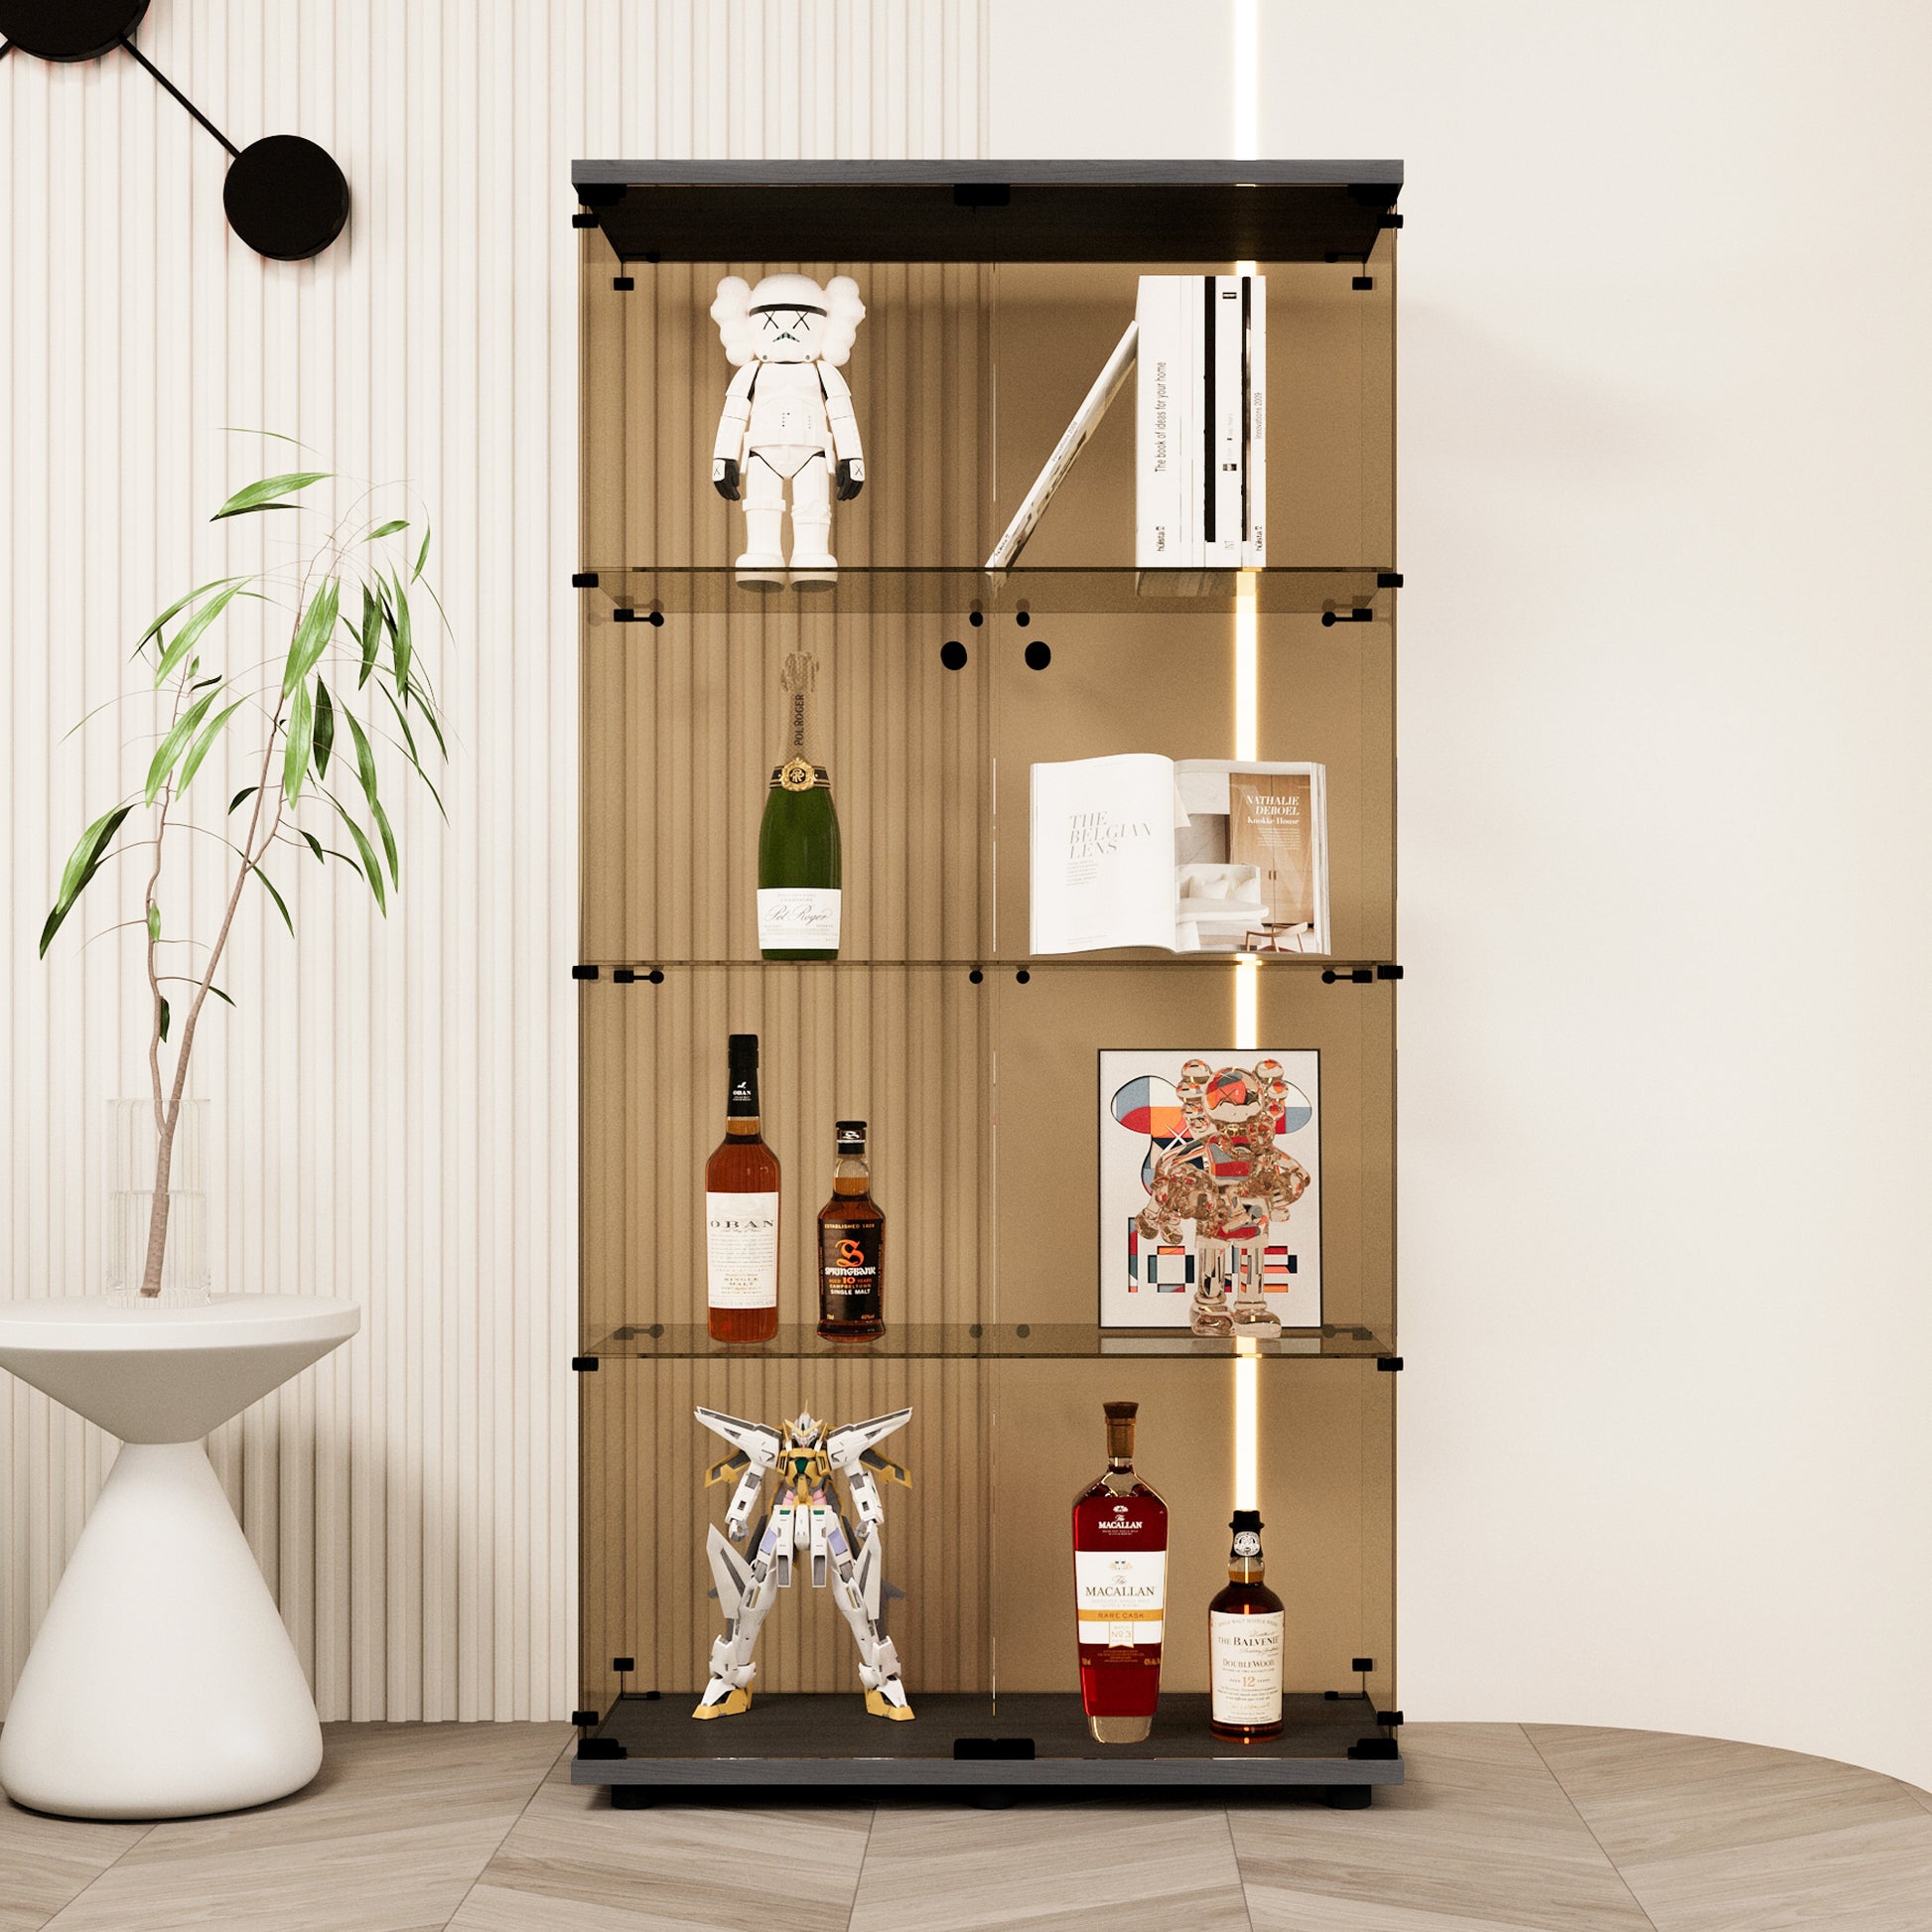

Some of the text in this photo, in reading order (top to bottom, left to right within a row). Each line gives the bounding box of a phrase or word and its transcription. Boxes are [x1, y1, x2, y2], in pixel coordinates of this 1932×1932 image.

[1155, 361, 1167, 381] home
[1157, 383, 1169, 399] your
[1155, 400, 1167, 410] for
[1155, 411, 1167, 430] ideas
[1254, 392, 1263, 440] Innovations 2009
[1155, 441, 1167, 458] book
[1155, 458, 1167, 473] The
[794, 694, 805, 746] POL ROGER
[1246, 795, 1300, 806] NATHALIE
[1255, 805, 1300, 816] DEBOEL
[1069, 811, 1108, 830] THE
[1069, 822, 1152, 845] BELGIAN
[1069, 840, 1118, 860] LENS
[710, 1219, 774, 1229] OBAN
[1085, 1587, 1155, 1596] MACALLAN
[1217, 1635, 1280, 1646] THE BALVENIE
[1243, 1676, 1256, 1687] 12
